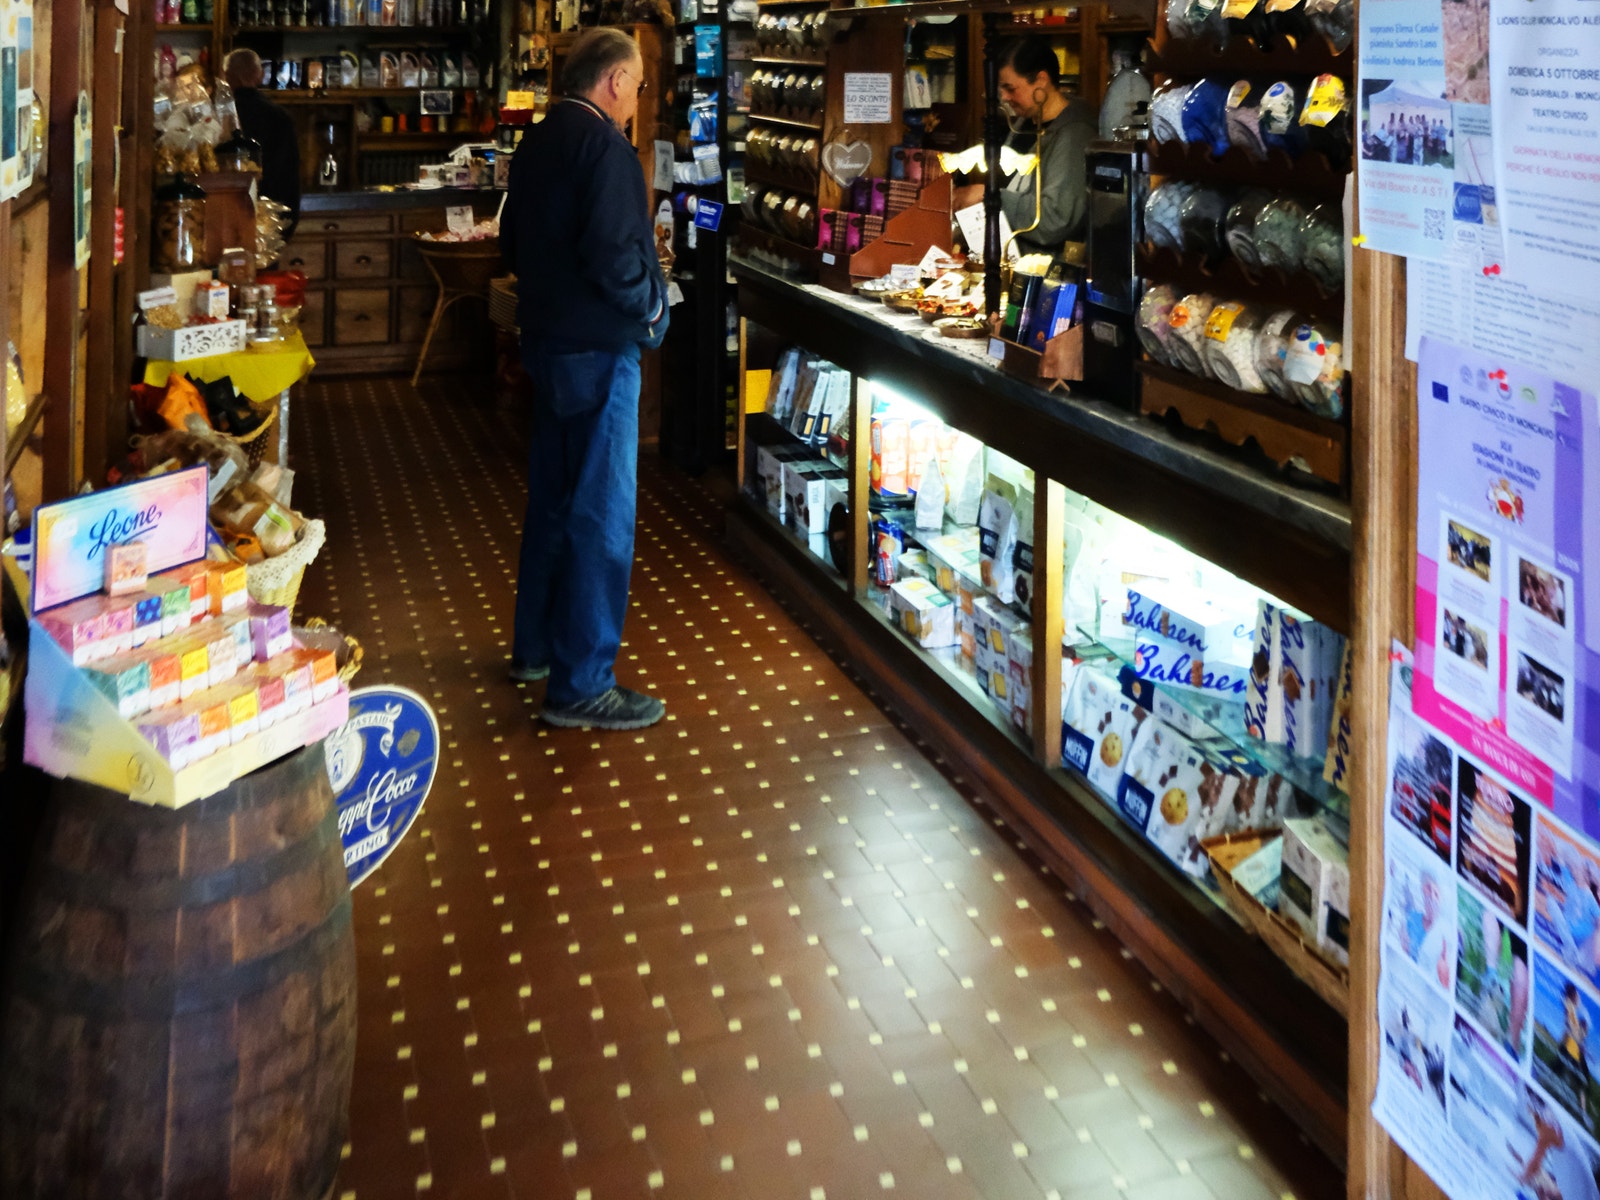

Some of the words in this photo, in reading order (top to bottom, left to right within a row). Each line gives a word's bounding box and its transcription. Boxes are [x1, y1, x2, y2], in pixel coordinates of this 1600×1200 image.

[1496, 16, 1519, 26] LIONS
[1520, 16, 1536, 26] CLUB
[1537, 16, 1580, 26] MONCALVO
[1583, 16, 1600, 26] ALE
[1395, 38, 1418, 48] Sandro
[1537, 47, 1580, 58] ORGANIZZA
[1392, 56, 1415, 66] Andrea
[1508, 66, 1545, 78] DOMENICA
[1546, 67, 1552, 78] 5
[1553, 67, 1600, 80] OTTOBRE
[858, 94, 889, 104] SCONTO
[1510, 86, 1529, 97] PIAZZA
[1530, 88, 1569, 99] GARIBALDI
[1532, 108, 1561, 119] TEATRO
[1562, 110, 1588, 121] CIVICO
[1459, 395, 1481, 412] TEATRO
[1482, 404, 1507, 420] CIVICO
[1515, 418, 1554, 440] MONCALVO
[1516, 461, 1541, 480] TEATRO
[87, 504, 162, 560] Leone
[1065, 736, 1088, 767] MUFFIN
[338, 798, 370, 839] eppe
[366, 767, 418, 833] Cocco
[345, 835, 384, 865] RTINO
